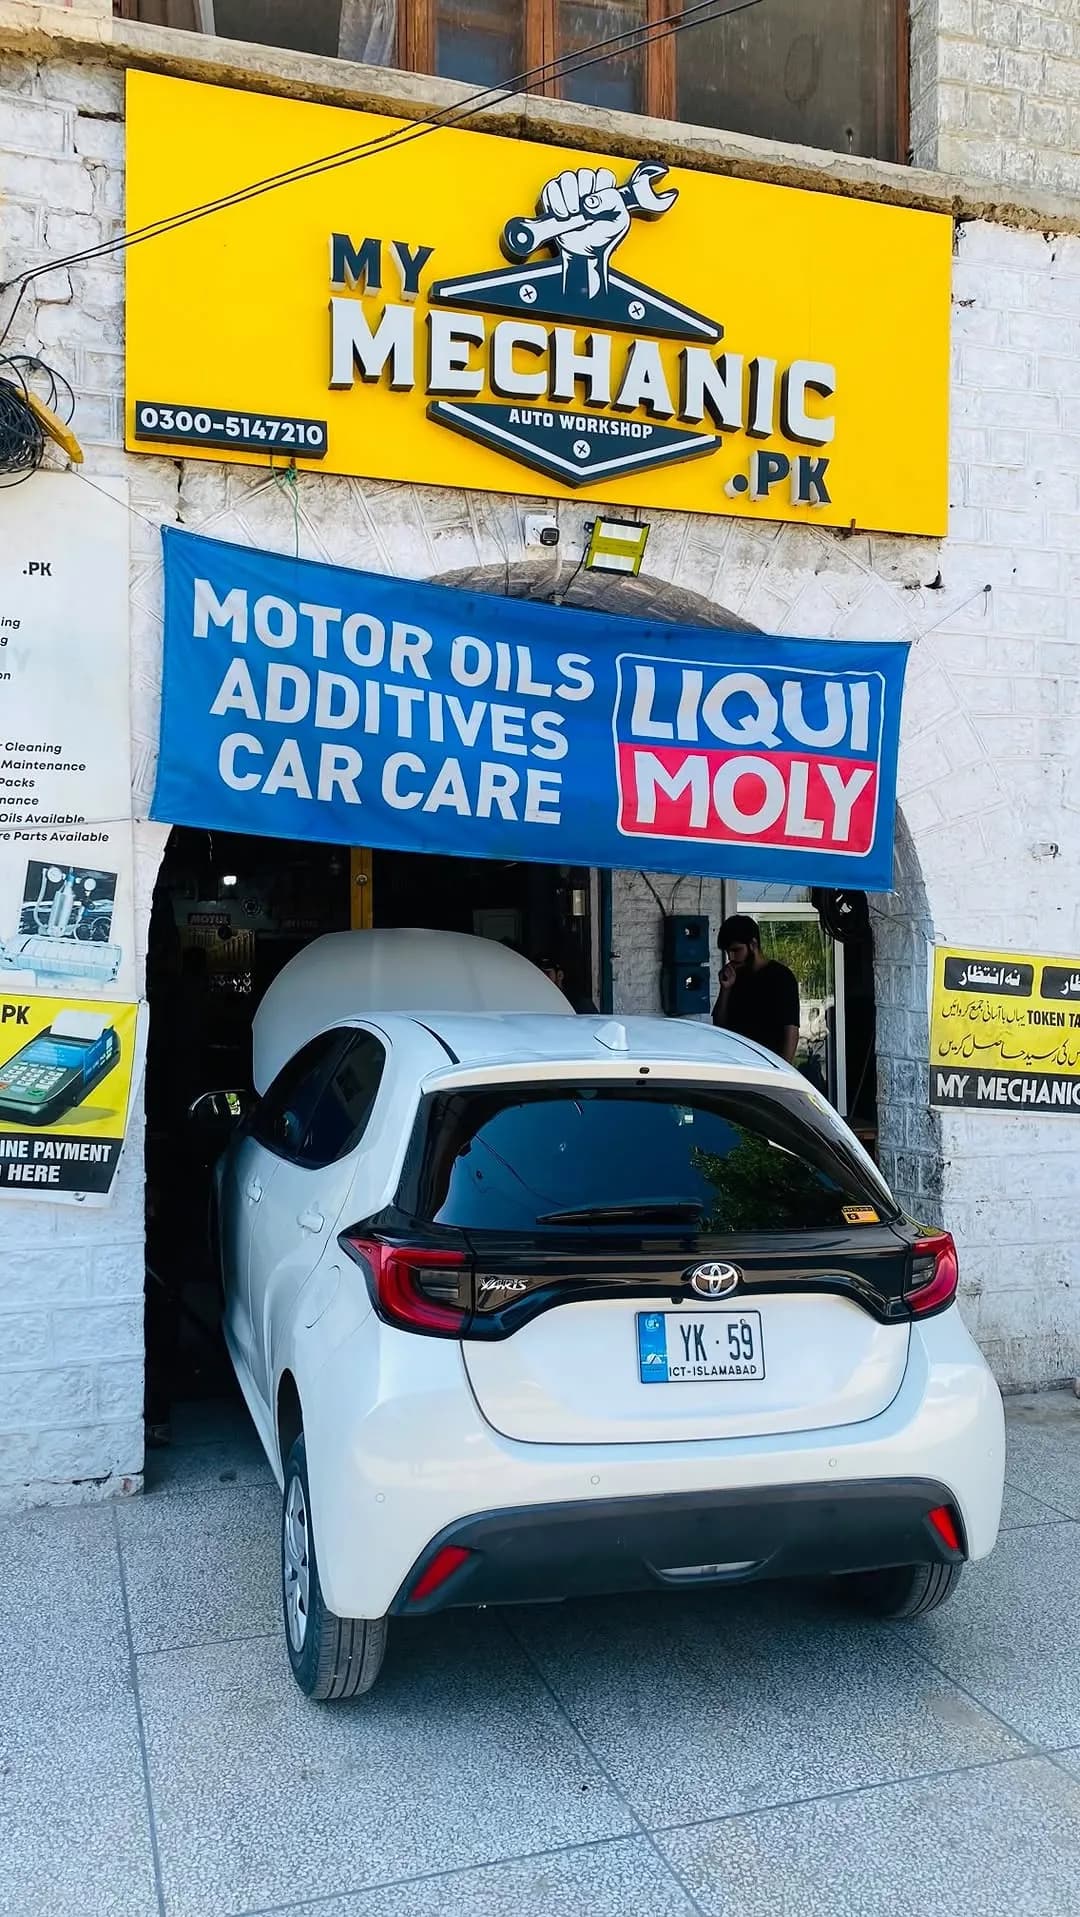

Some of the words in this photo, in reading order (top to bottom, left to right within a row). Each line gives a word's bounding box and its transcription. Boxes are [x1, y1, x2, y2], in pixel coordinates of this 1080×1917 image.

[330, 233, 435, 297] MY
[329, 298, 837, 444] MECHANIC
[140, 408, 323, 444] 0300-5147210
[509, 409, 554, 427] AUTO
[559, 414, 654, 439] WORKSHOP
[729, 450, 832, 505] .PK
[22, 561, 52, 577] .PK
[193, 578, 432, 680] MOTOR
[450, 636, 596, 701] OILS
[209, 657, 569, 761] ADDITIVES
[631, 665, 871, 751] LIQUI
[5, 742, 62, 755] Cleaning
[1, 760, 86, 771] Maintenance
[218, 732, 362, 804] CAR
[381, 752, 563, 824] CARE
[633, 750, 873, 842] MOLY
[0, 813, 22, 822] Oils
[25, 814, 85, 824] Available
[14, 832, 47, 841] Parts
[50, 832, 109, 842] Available
[1027, 1010, 1065, 1026] TOKEN
[937, 1073, 970, 1098] MY
[33, 1141, 112, 1162] PAYMENT
[8, 1164, 60, 1182] HERE
[480, 1278, 528, 1291] YARIS
[680, 1324, 707, 1361] YK
[727, 1324, 754, 1360] 59
[669, 1365, 757, 1377] ICT-ISLAMABAD
